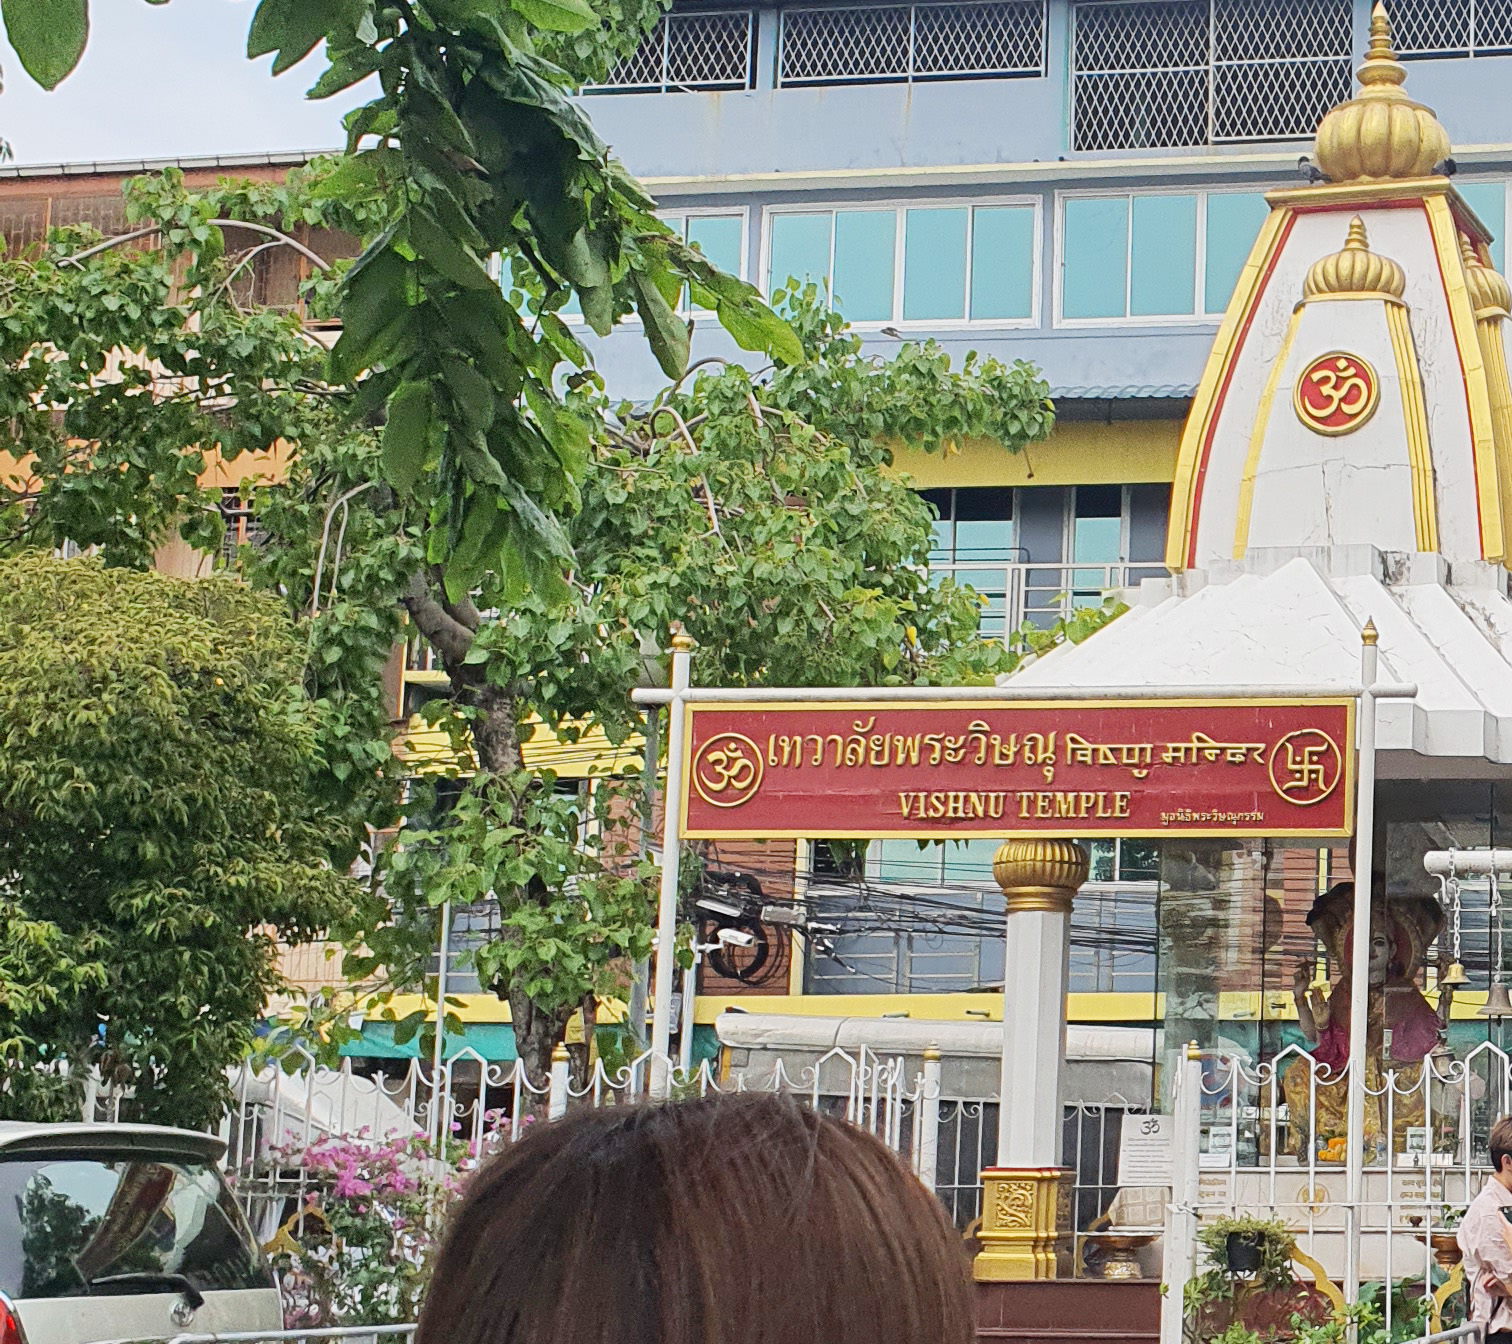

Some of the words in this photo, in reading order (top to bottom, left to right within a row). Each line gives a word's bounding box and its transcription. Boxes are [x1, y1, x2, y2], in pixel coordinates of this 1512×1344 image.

[767, 716, 1057, 783] เทวาลัยพระวิษณุ
[898, 792, 1006, 819] VISHNU
[1016, 791, 1131, 818] TEMPLE
